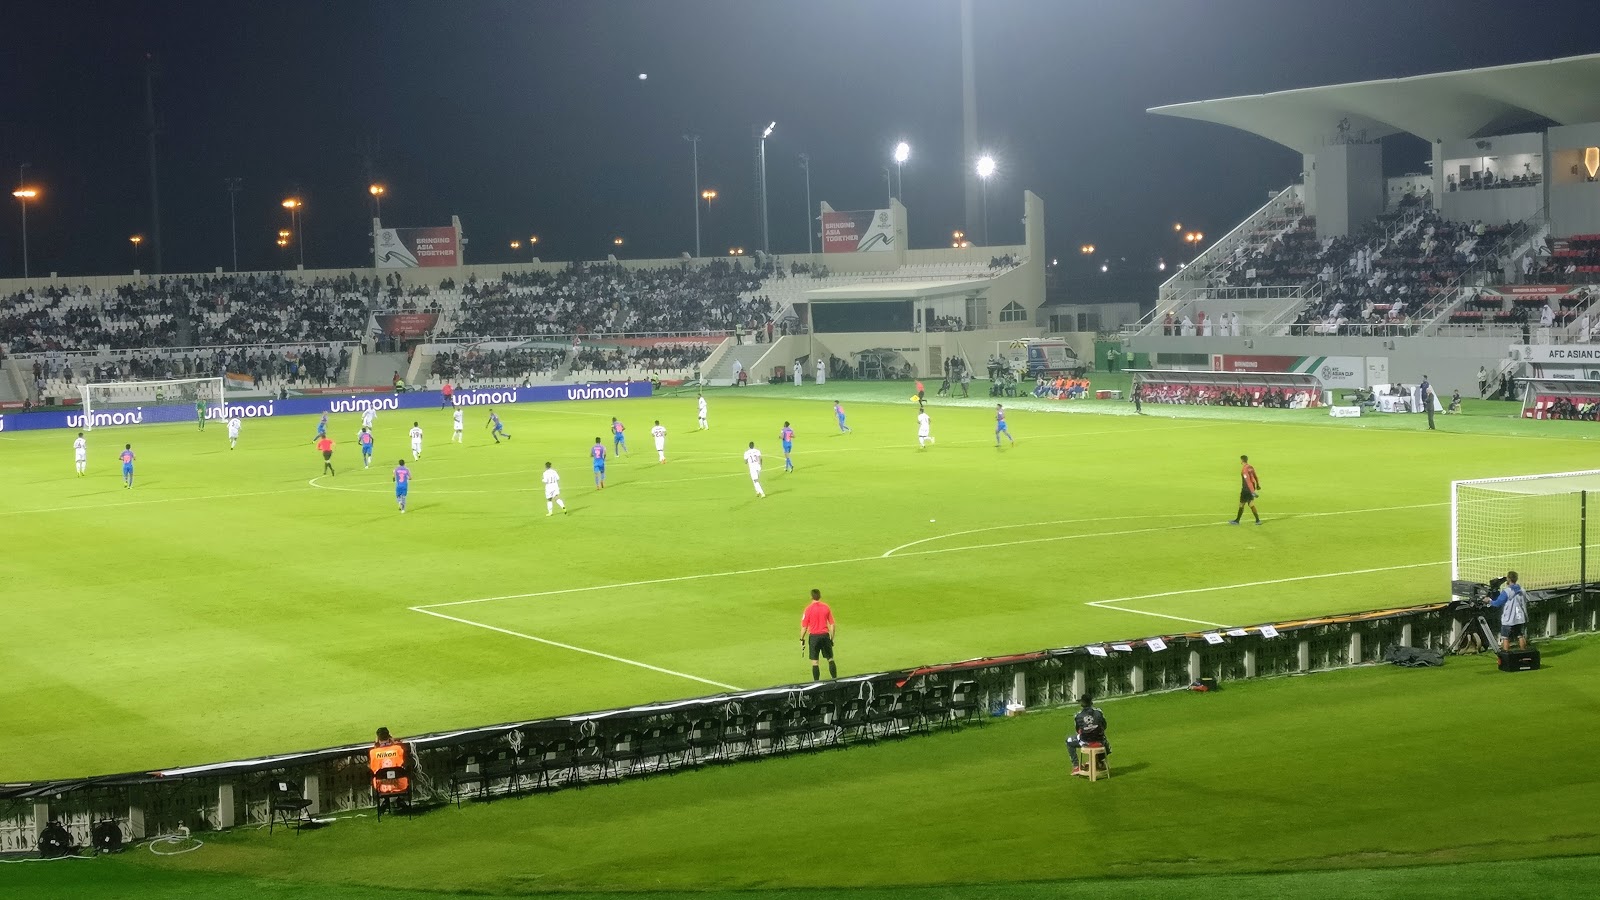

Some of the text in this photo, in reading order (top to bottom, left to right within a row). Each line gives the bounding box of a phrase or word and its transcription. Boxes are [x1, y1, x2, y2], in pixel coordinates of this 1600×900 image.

[1549, 350, 1565, 358] AFC
[452, 387, 517, 406] unimoni
[568, 382, 629, 401] unimoni
[205, 400, 274, 420] unimoni
[330, 393, 399, 413] unimoni
[66, 407, 143, 428] unimoni
[750, 454, 758, 464] 13
[376, 751, 397, 759] Nikon
